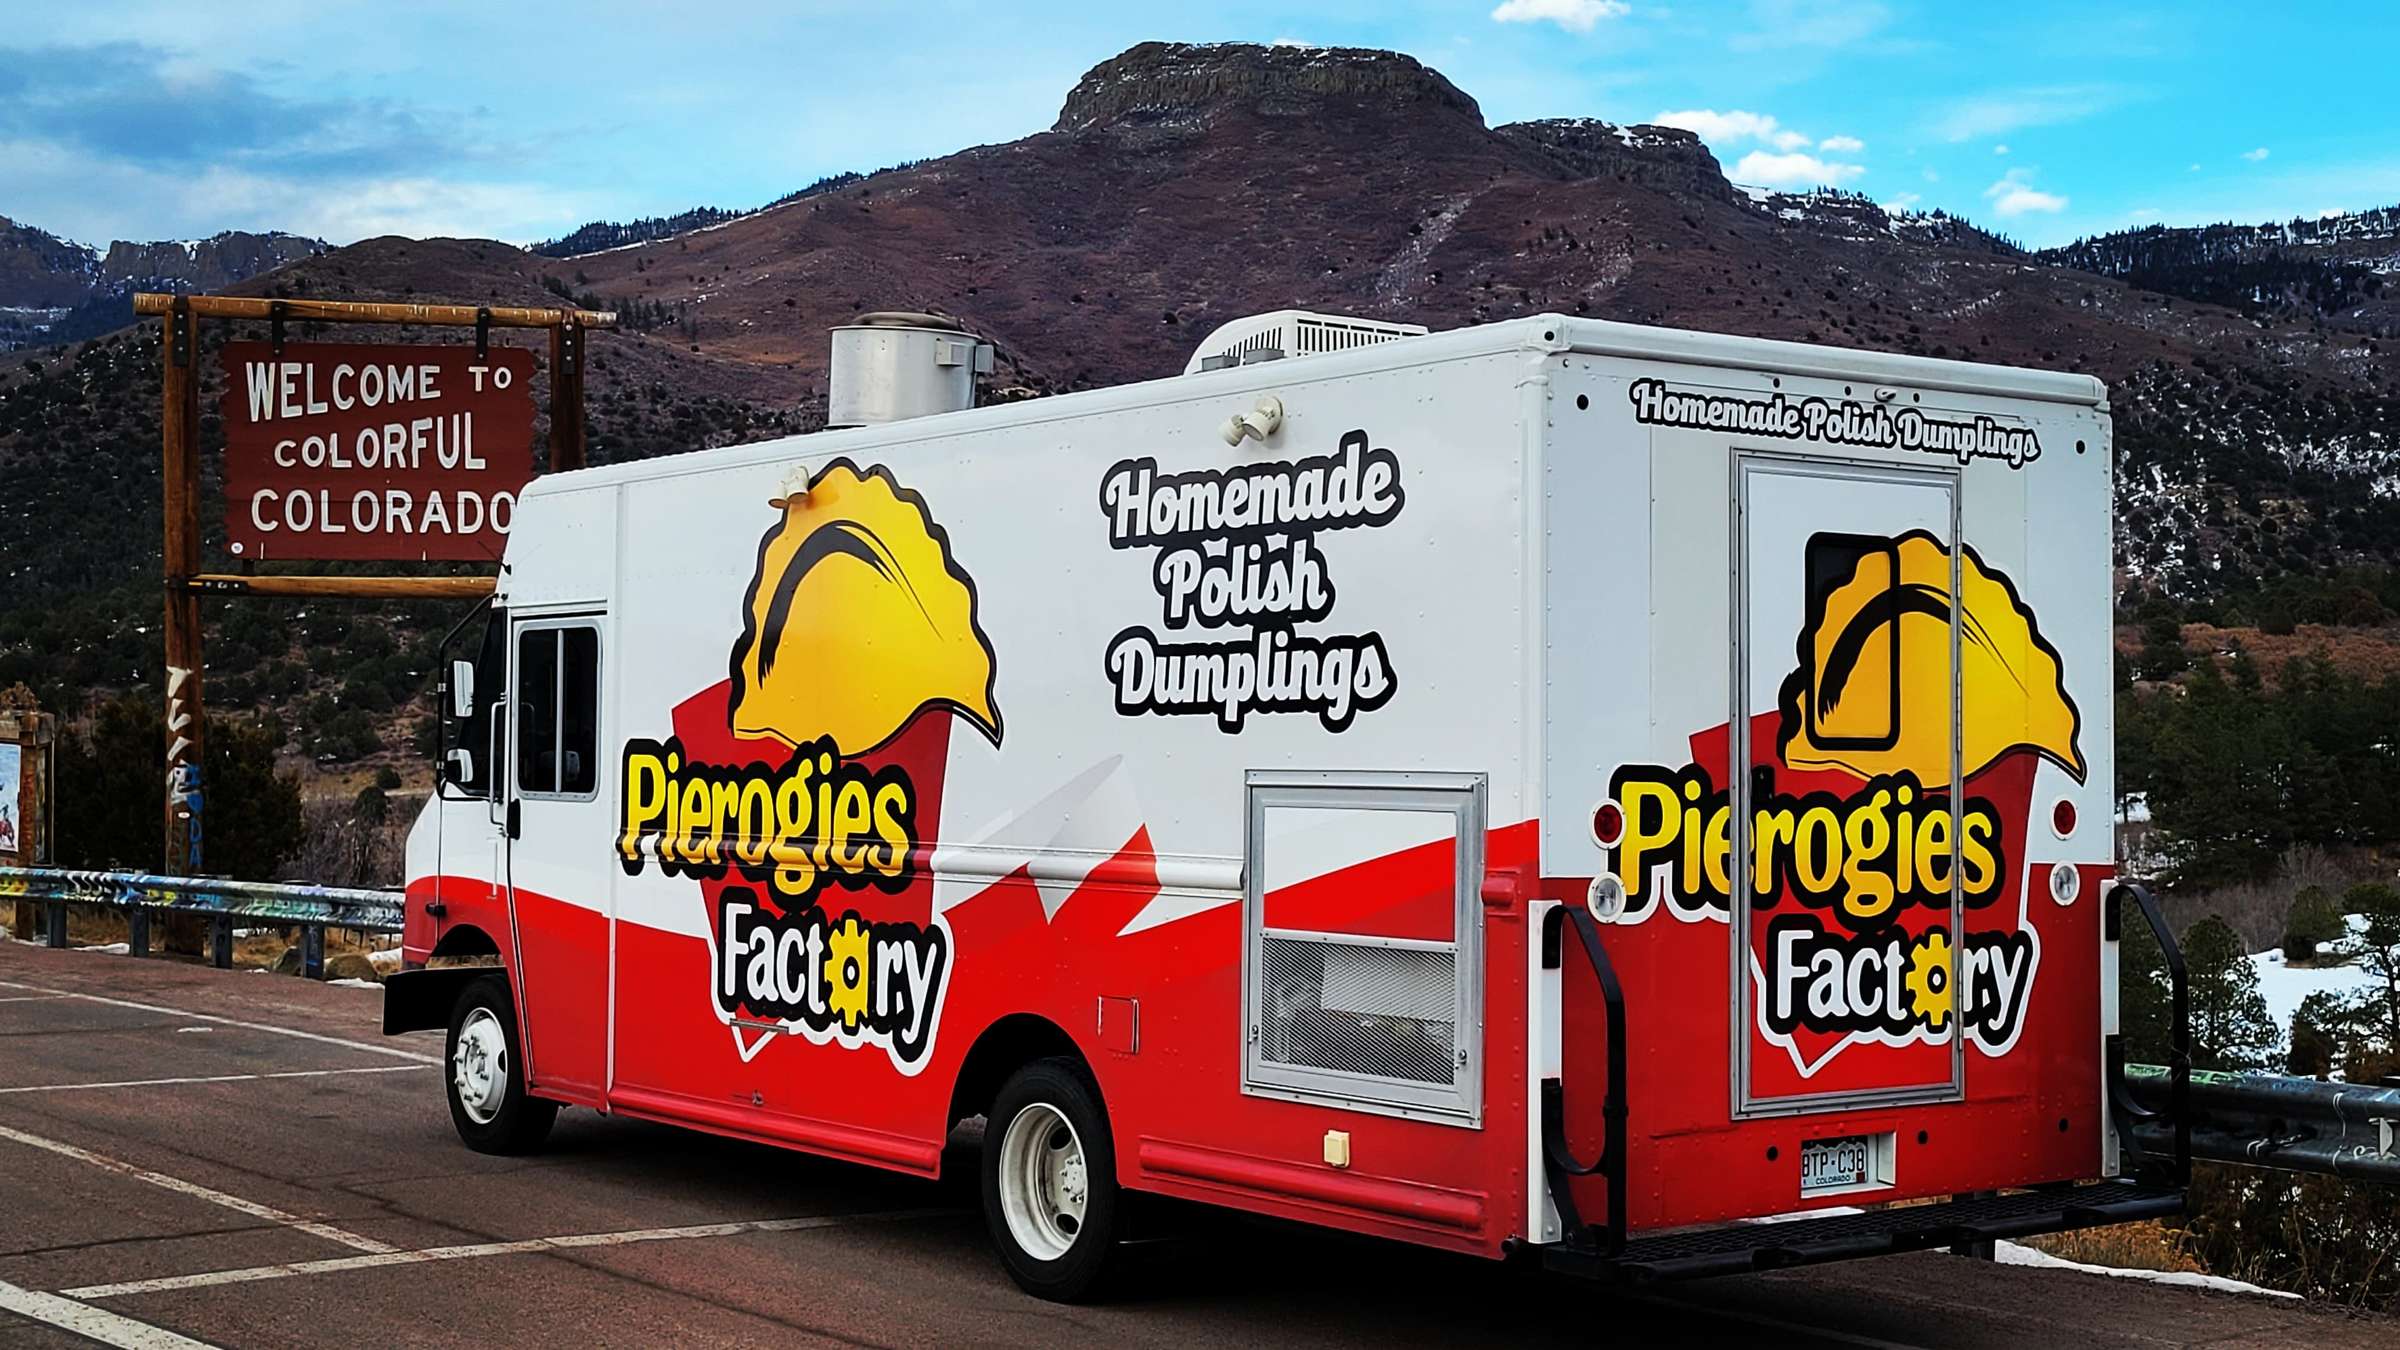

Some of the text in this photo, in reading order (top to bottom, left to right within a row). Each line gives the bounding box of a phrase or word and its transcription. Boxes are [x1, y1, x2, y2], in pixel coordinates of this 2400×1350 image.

[245, 361, 512, 422] WELCOME TO
[1632, 382, 2038, 465] Homemade Polish Dumplings
[273, 411, 486, 470] COLORFUL
[251, 488, 516, 535] COLORADO
[1106, 442, 1397, 538] Homemade
[1160, 539, 1328, 619] Polish
[1111, 630, 1389, 722] Dumplings
[622, 751, 910, 896] Pierogies
[1620, 779, 1996, 918] Pierogies
[724, 903, 937, 1044] Factory
[1777, 929, 2024, 1028] Factory
[1816, 1175, 1851, 1184] COLORADO
